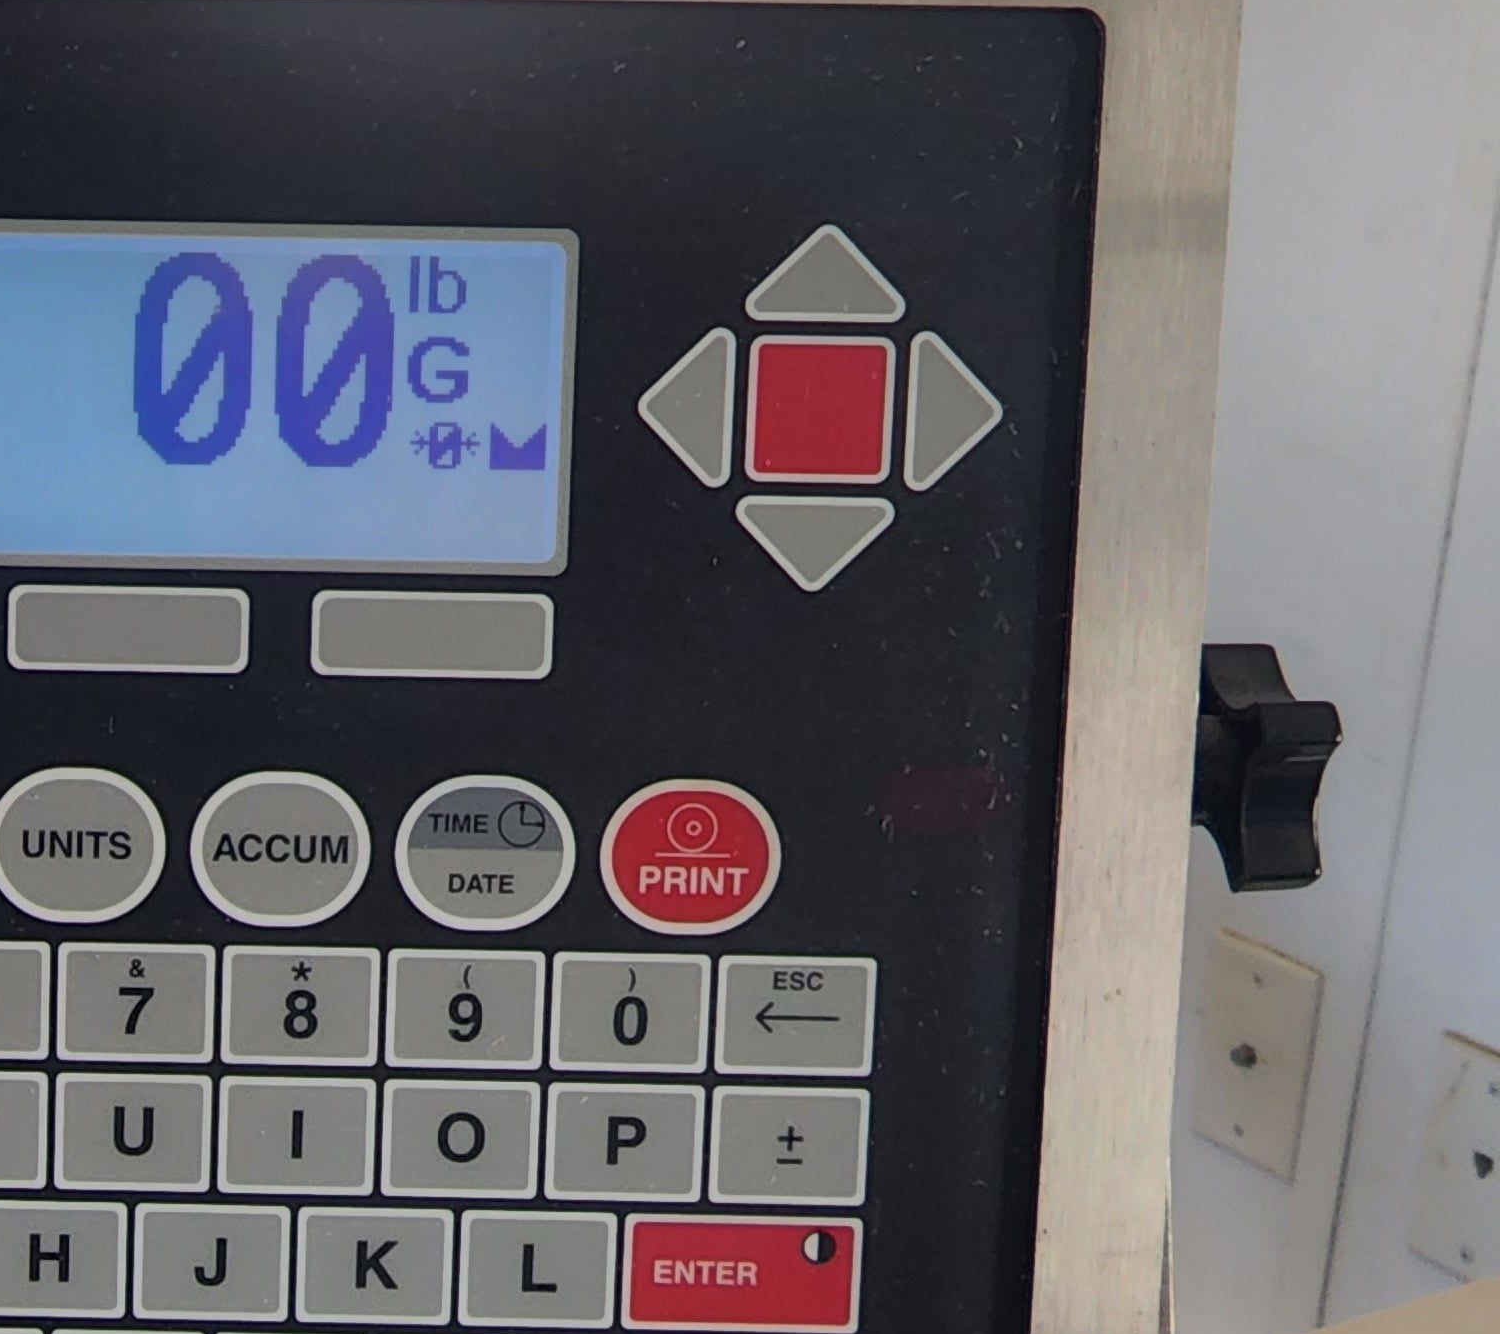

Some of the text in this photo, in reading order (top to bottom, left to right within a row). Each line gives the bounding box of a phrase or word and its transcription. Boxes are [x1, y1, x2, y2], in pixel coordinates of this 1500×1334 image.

[134, 251, 468, 470] 00 lb
[408, 336, 470, 403] G
[23, 830, 131, 859] UNITS
[428, 813, 489, 835] TIME
[213, 834, 348, 863] ACCUM
[448, 873, 515, 895] DATE
[638, 866, 749, 897] PRINT
[129, 959, 145, 978] &
[772, 970, 824, 992] ESC
[119, 987, 154, 1034] 7
[284, 990, 317, 1039] 8
[449, 993, 482, 1042] 9
[613, 996, 648, 1045] 0
[114, 1106, 154, 1156] U
[292, 1110, 303, 1158] I
[438, 1112, 485, 1163] O
[607, 1116, 646, 1165] P
[29, 1234, 69, 1282] H
[194, 1238, 227, 1286] J
[356, 1240, 398, 1289] K
[522, 1244, 557, 1292] L
[653, 1260, 758, 1287] ENTER
